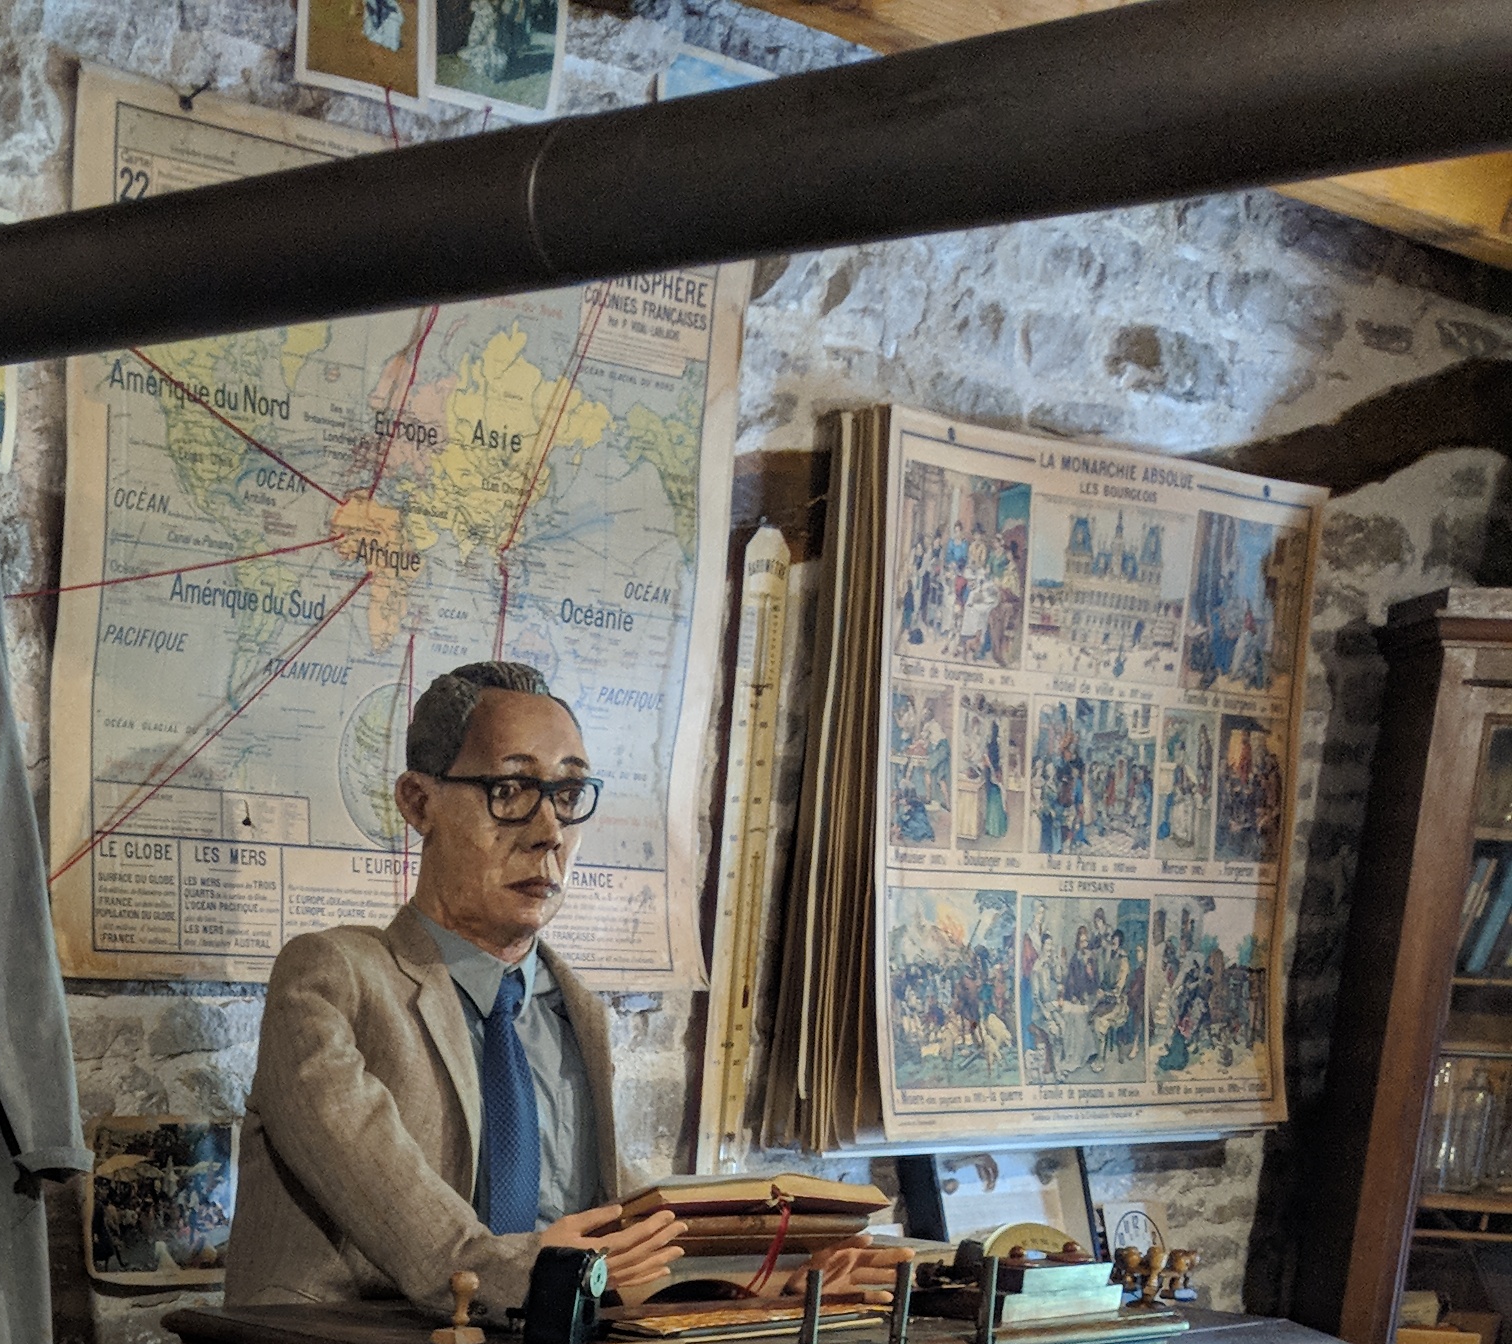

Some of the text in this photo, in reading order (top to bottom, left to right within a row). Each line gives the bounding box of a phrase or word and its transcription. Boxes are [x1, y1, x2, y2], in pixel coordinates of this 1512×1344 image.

[119, 166, 150, 200] 22
[583, 284, 638, 316] COLONIES
[642, 299, 707, 331] FRANÇAISES
[108, 357, 211, 411] Amérique
[213, 382, 239, 412] du
[243, 384, 291, 421] Nord
[374, 409, 439, 451] Europe
[470, 418, 524, 453] Asie
[1039, 451, 1194, 491] LA MONARCHIE ABSOLUE
[113, 486, 171, 515] OCÉAN
[1079, 481, 1099, 496] LES
[354, 536, 422, 577] Afrique
[169, 571, 327, 622] Amérique du Sud
[623, 580, 672, 606] OCÉAN
[560, 597, 635, 633] Océanie
[103, 623, 189, 654] PACIFIQUE
[263, 657, 354, 687] ATLANTIQUE
[596, 685, 666, 713] PACIFIQUE
[99, 839, 173, 861] LE GLOBE
[194, 845, 268, 867] LES MERS
[352, 855, 420, 877] L'EUROPE
[572, 870, 614, 889] RANCE
[99, 895, 134, 907] FRANCE
[102, 932, 136, 944] FRANCE
[233, 938, 271, 950] AUSTRAL
